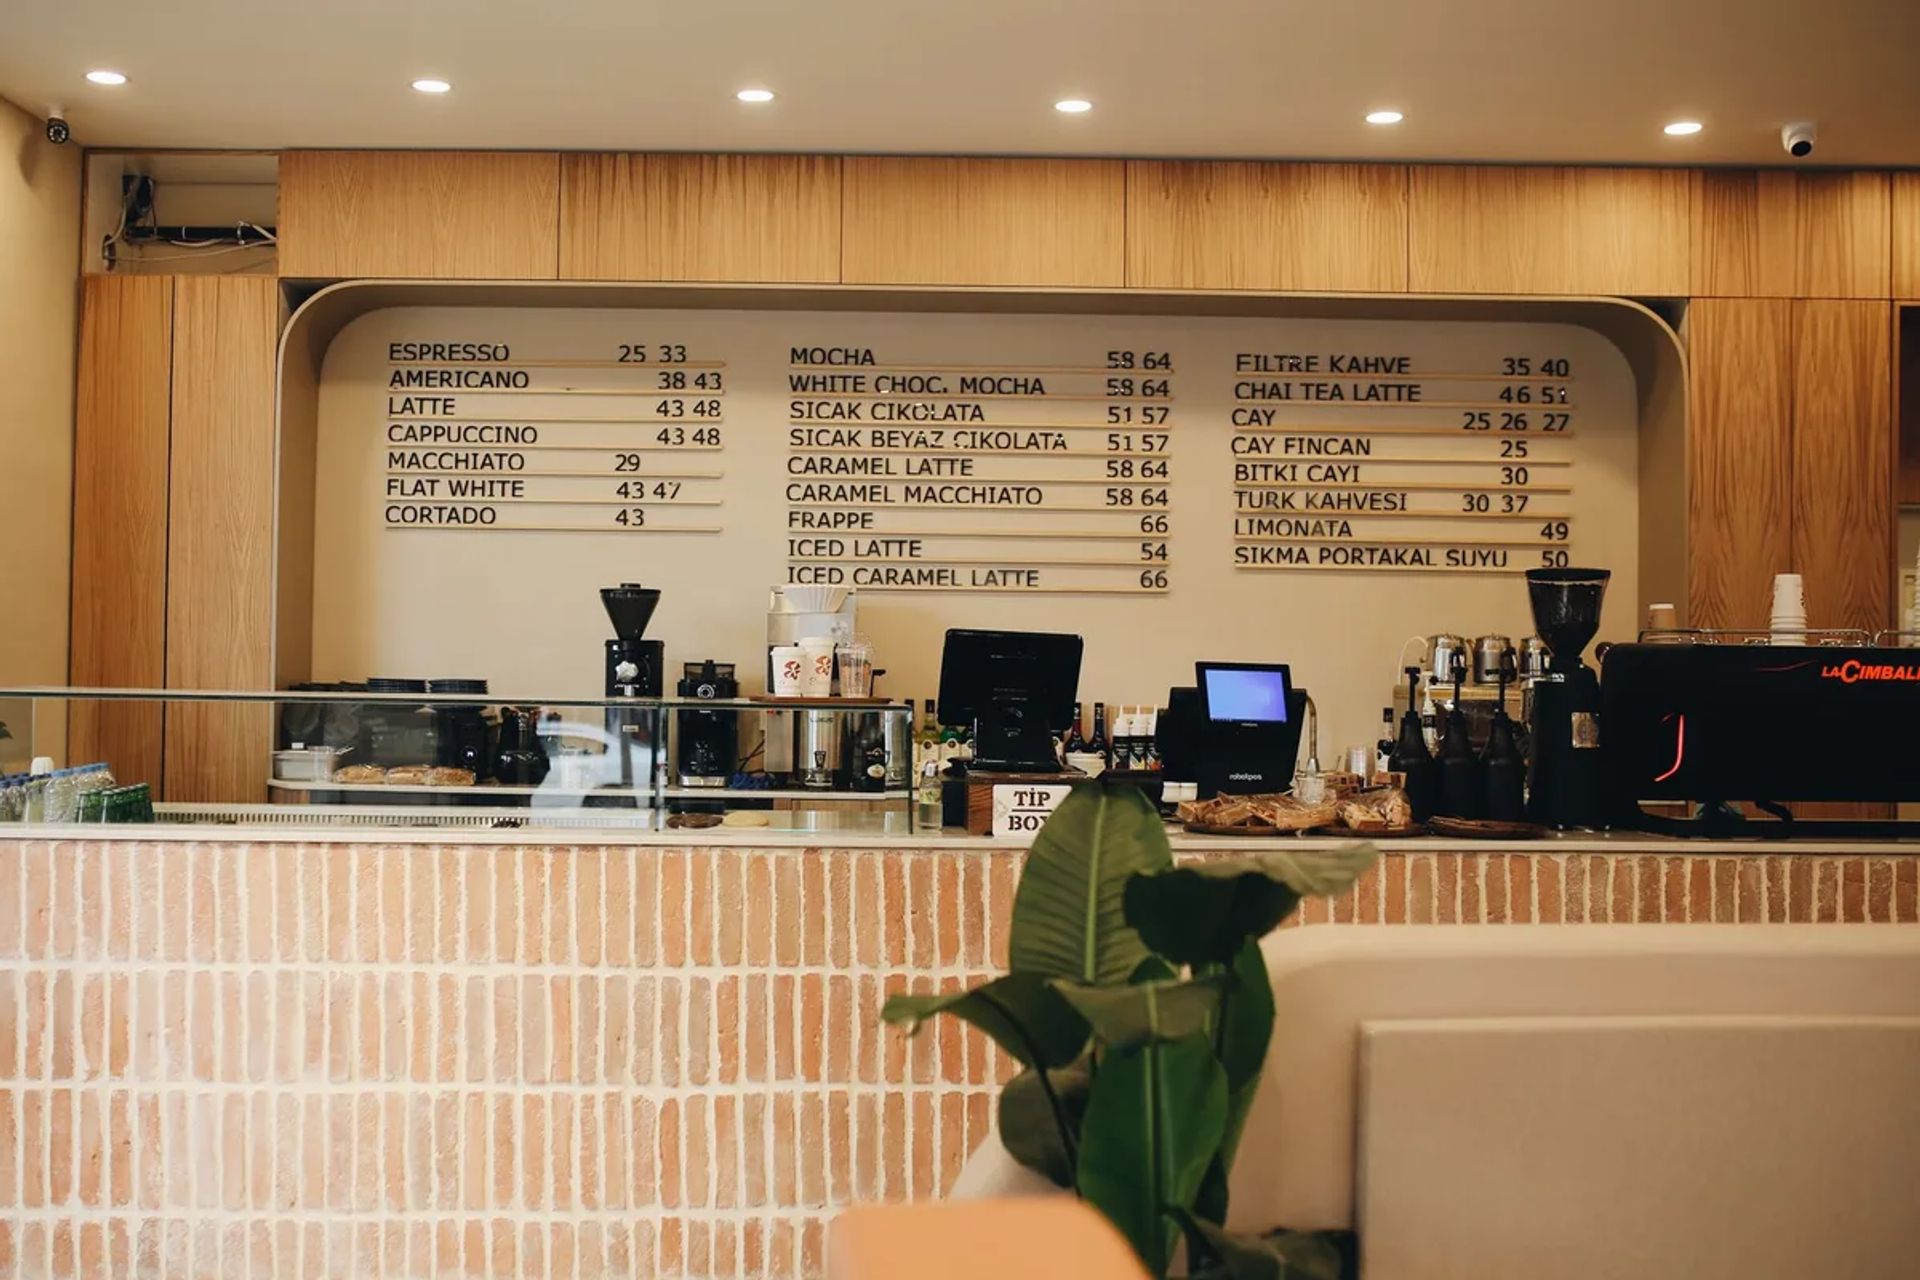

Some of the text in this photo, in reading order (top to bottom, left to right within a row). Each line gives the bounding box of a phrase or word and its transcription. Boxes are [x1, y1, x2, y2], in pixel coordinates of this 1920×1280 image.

[389, 343, 687, 363] ESPRESSO 25 33
[790, 347, 1171, 370] MOCHA 58 64
[1236, 354, 1569, 377] FILTRE KAHVE 35 40
[389, 370, 722, 391] AMERICANO 38 43
[789, 375, 1170, 397] WHITE CHOC. MOCHA 58 64
[1234, 382, 1567, 405] CHAI TEA LATTE 46 51
[388, 397, 721, 418] LATTE 43 48
[790, 402, 1169, 424] SICAK CIKOLATA 51 57
[1231, 408, 1570, 431] CAY 25 26 27
[387, 425, 721, 445] CAPPUCCINO 43 48
[789, 429, 1169, 452] SICAK BEYAZ CIKOLATA 51 57
[1230, 436, 1528, 458] CAY FINCAN 25
[388, 452, 641, 472] MACCHIATO 29
[787, 456, 1168, 479] CARAMEL LATTE 58 64
[1235, 464, 1528, 485] BITKI CAYI 30
[387, 479, 682, 500] FLAT WHITE 43 47
[785, 484, 1168, 507] CARAMEL MACCHIATO 58 64
[1234, 490, 1529, 513] TURK KAHVESI 30 37
[385, 506, 645, 527] CORTADO 43
[788, 511, 1168, 534] FRAPPE 66
[1235, 519, 1569, 540] LIMONATA 49
[788, 538, 1168, 561] ICED LATTE 54
[1234, 546, 1569, 569] SIKMA PORTAKAL SUYU 50
[787, 566, 1168, 589] ICED CARAMEL LATTE 66
[1013, 787, 1051, 806] TİP
